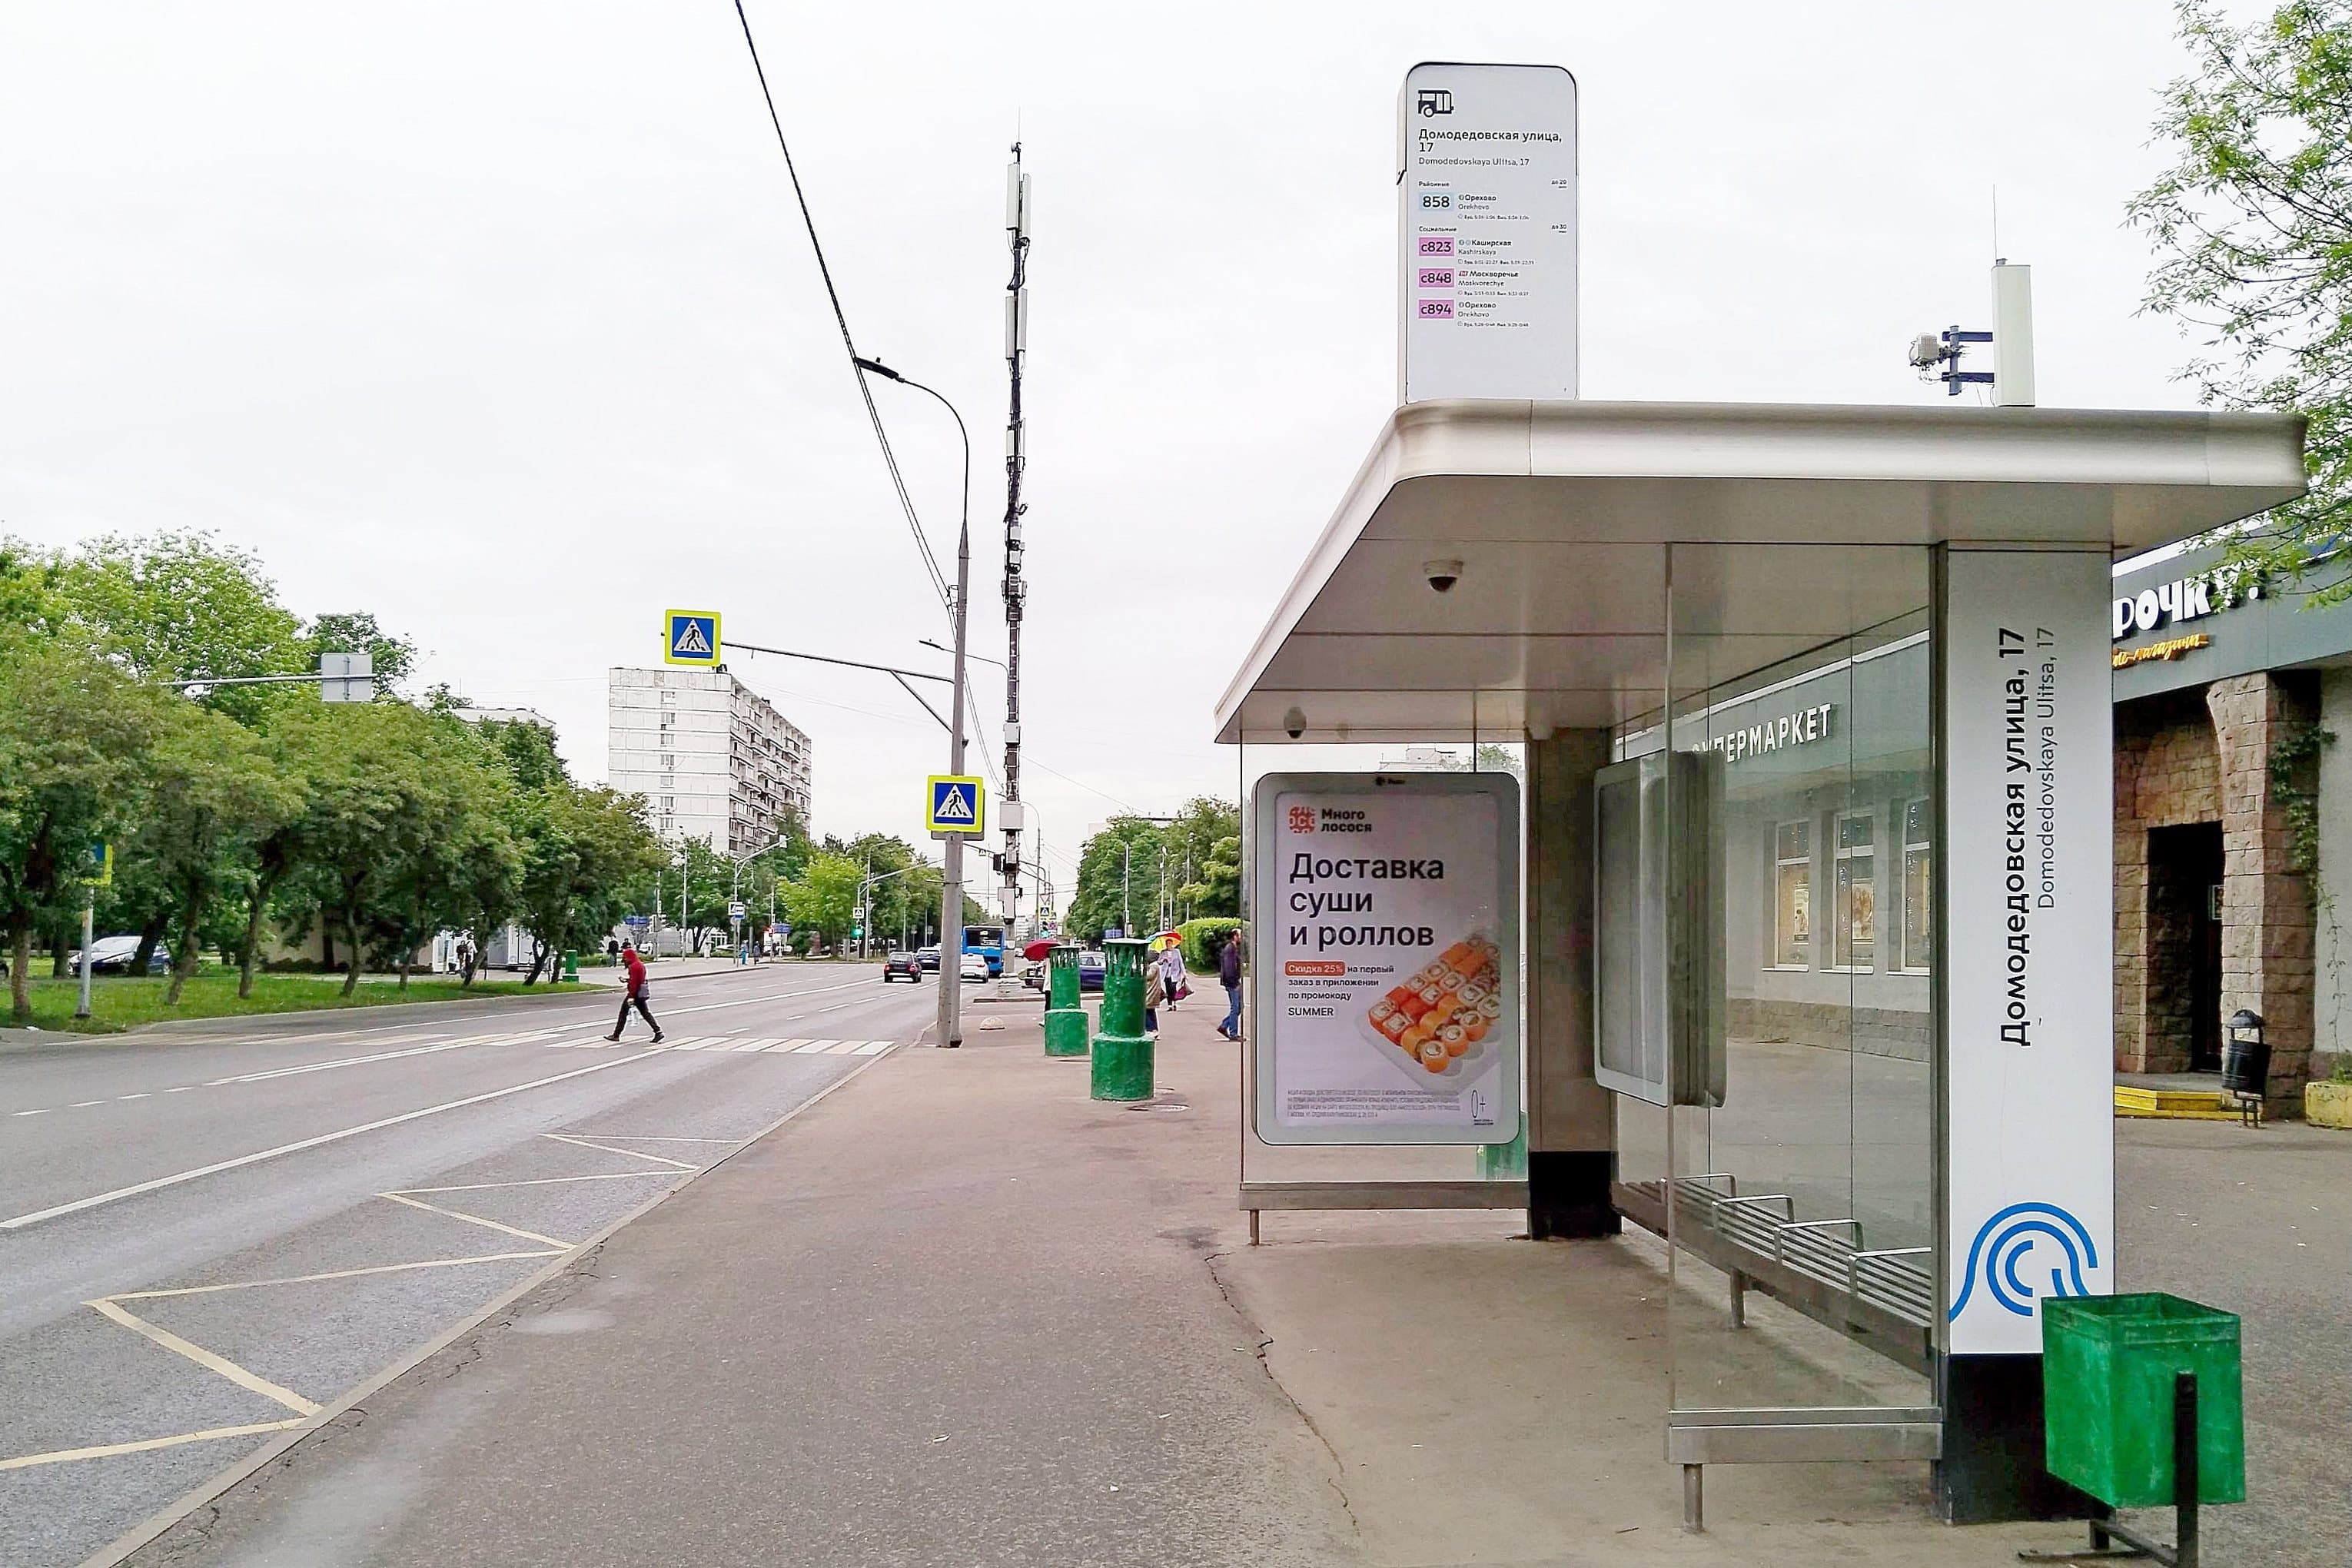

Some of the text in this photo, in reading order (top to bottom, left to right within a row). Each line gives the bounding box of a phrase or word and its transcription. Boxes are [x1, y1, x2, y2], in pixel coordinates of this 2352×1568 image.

[1419, 128, 1562, 143] Домодедовская улица,
[1419, 142, 1433, 152] 17
[1419, 158, 1490, 167] Domodedovskaya
[1423, 195, 1450, 208] 858
[2037, 628, 2059, 909] Domodedovskaya Ulitsa, 17
[1321, 809, 1365, 820] Много
[1321, 823, 1372, 832] лосося
[1999, 628, 2031, 1046] Домодедовская улица, 17
[1289, 853, 1443, 884] Доставка
[1290, 892, 1373, 919] суши
[1291, 926, 1434, 952] и роллов
[1288, 965, 1322, 973] Скидка
[1324, 965, 1344, 973] 25%
[1360, 965, 1394, 974] первый
[1301, 992, 1352, 1001] промокоду
[1288, 1007, 1334, 1016] SUMMER
